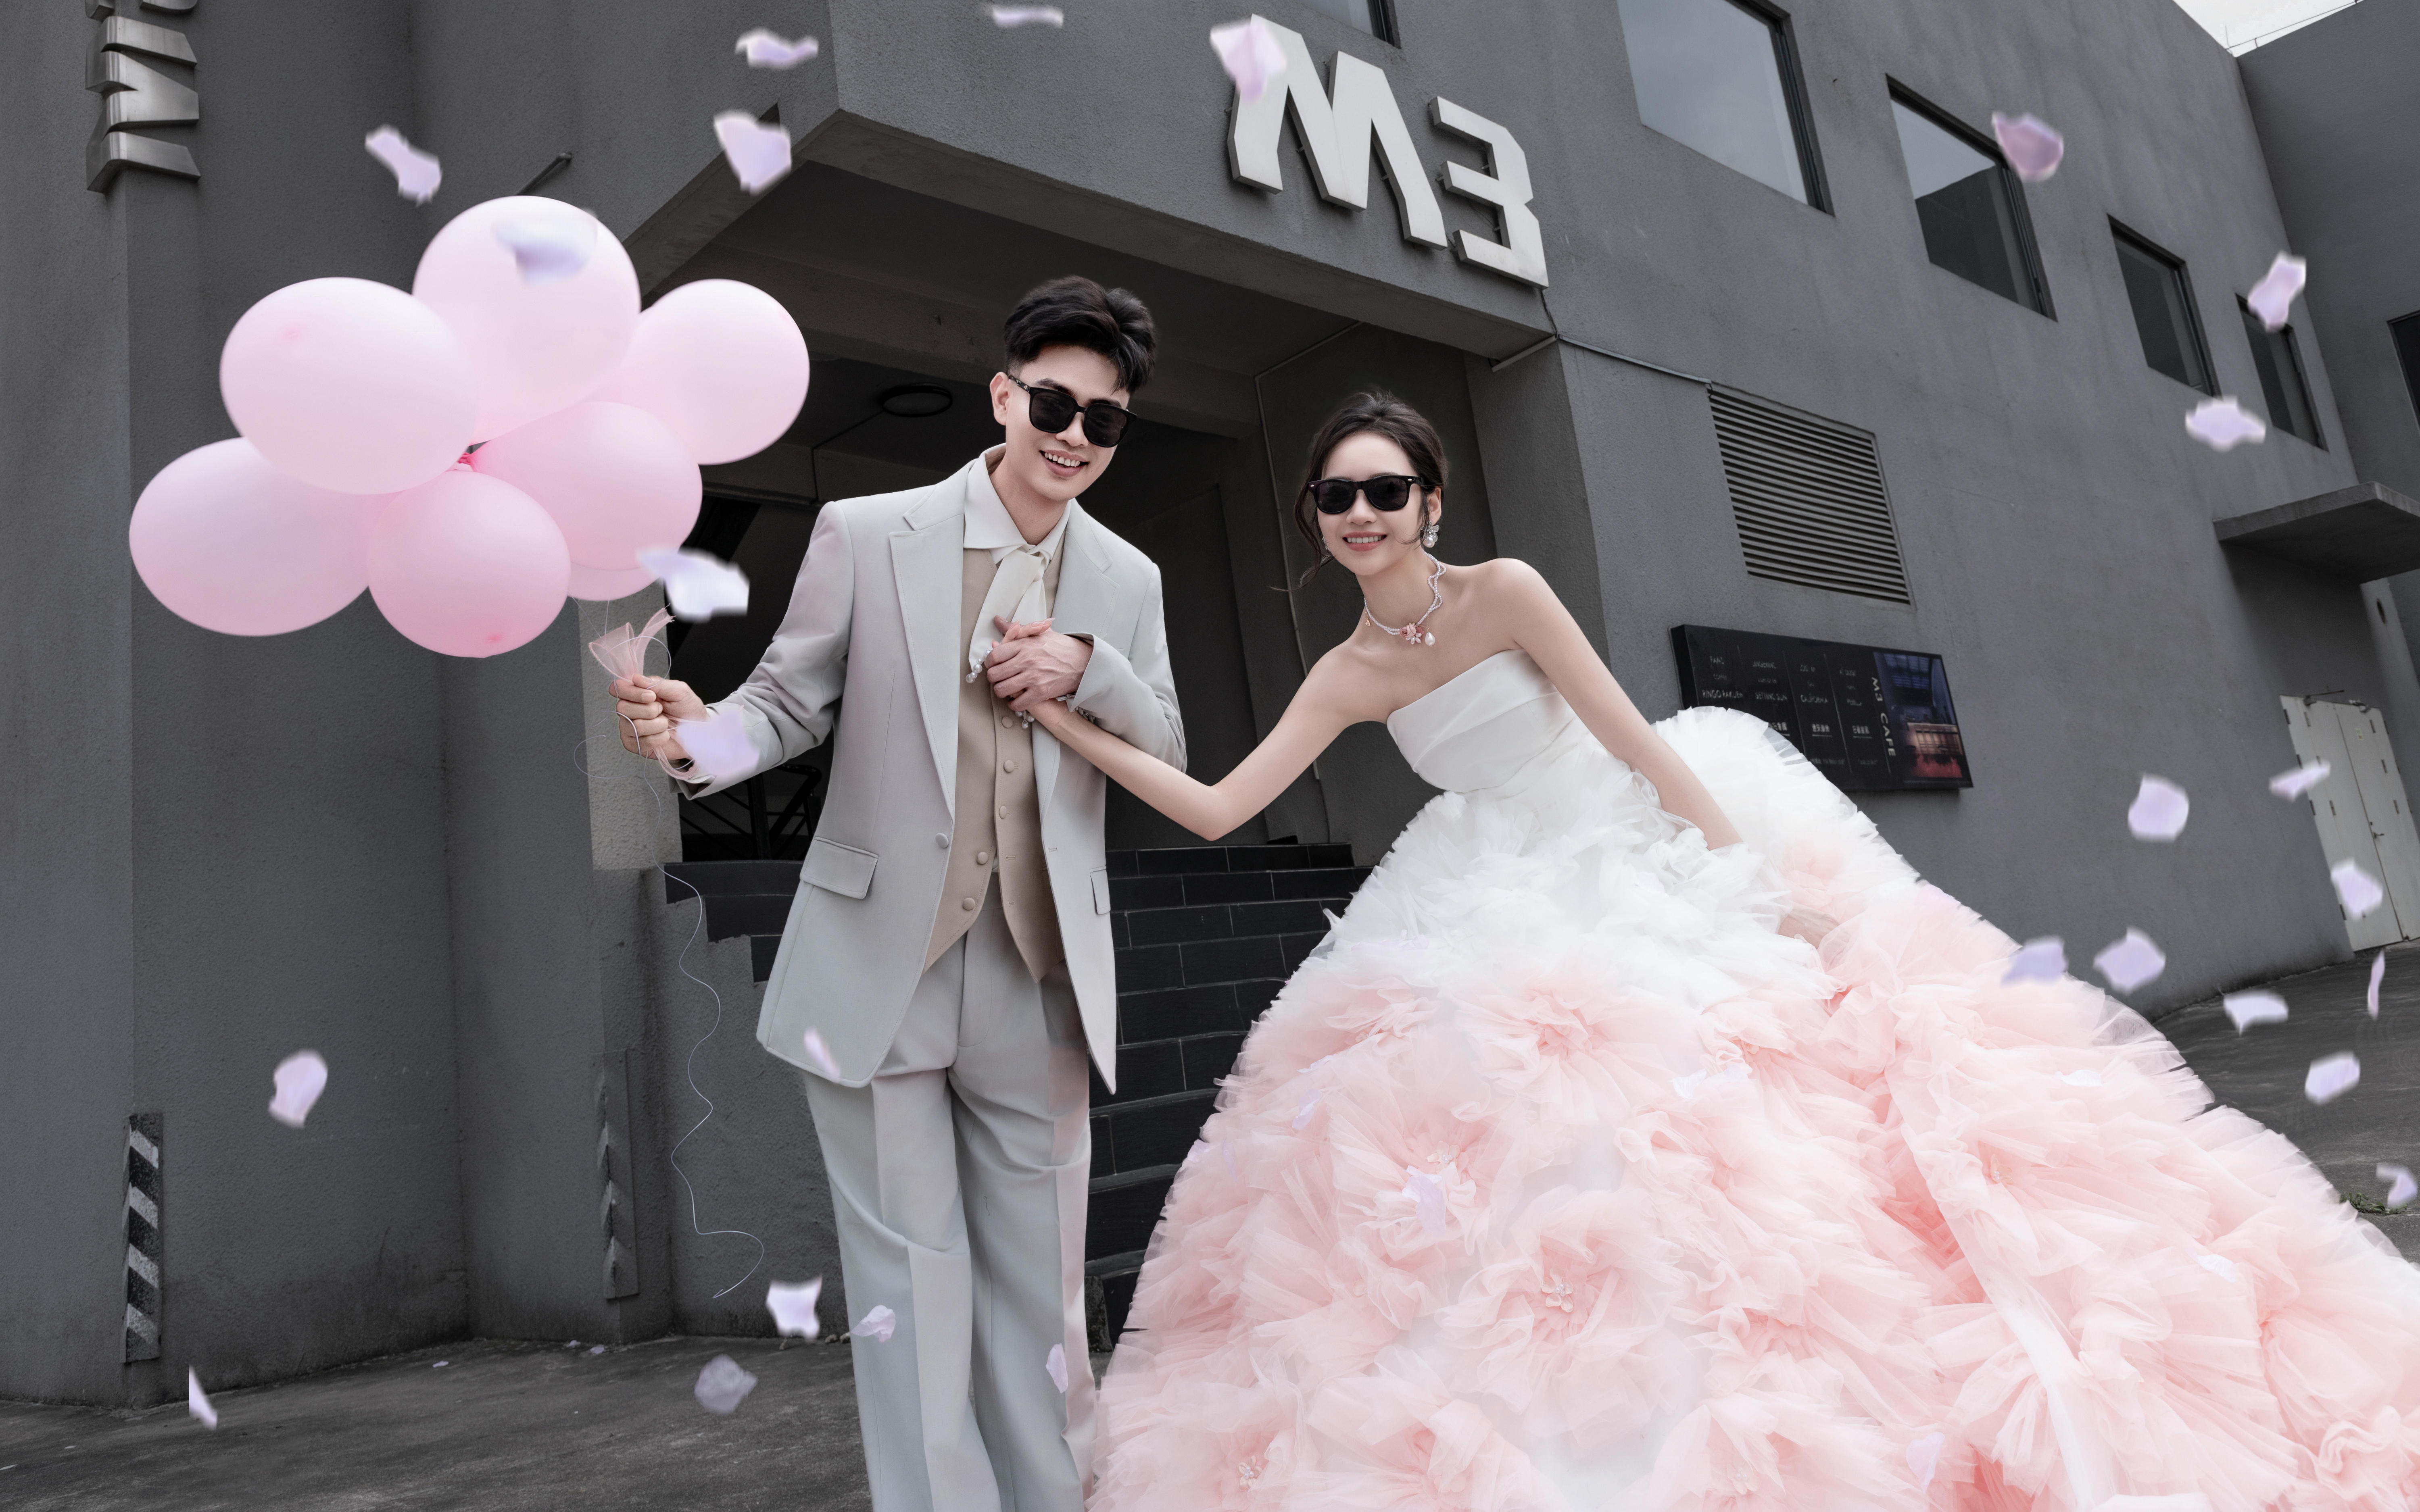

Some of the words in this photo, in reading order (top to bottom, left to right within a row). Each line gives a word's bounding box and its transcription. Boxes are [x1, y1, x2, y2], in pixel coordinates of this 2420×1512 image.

[1227, 14, 1548, 290] M3
[1702, 689, 1721, 698] RINGO
[1871, 677, 1883, 701] M3
[1880, 712, 1896, 756] CAFE
